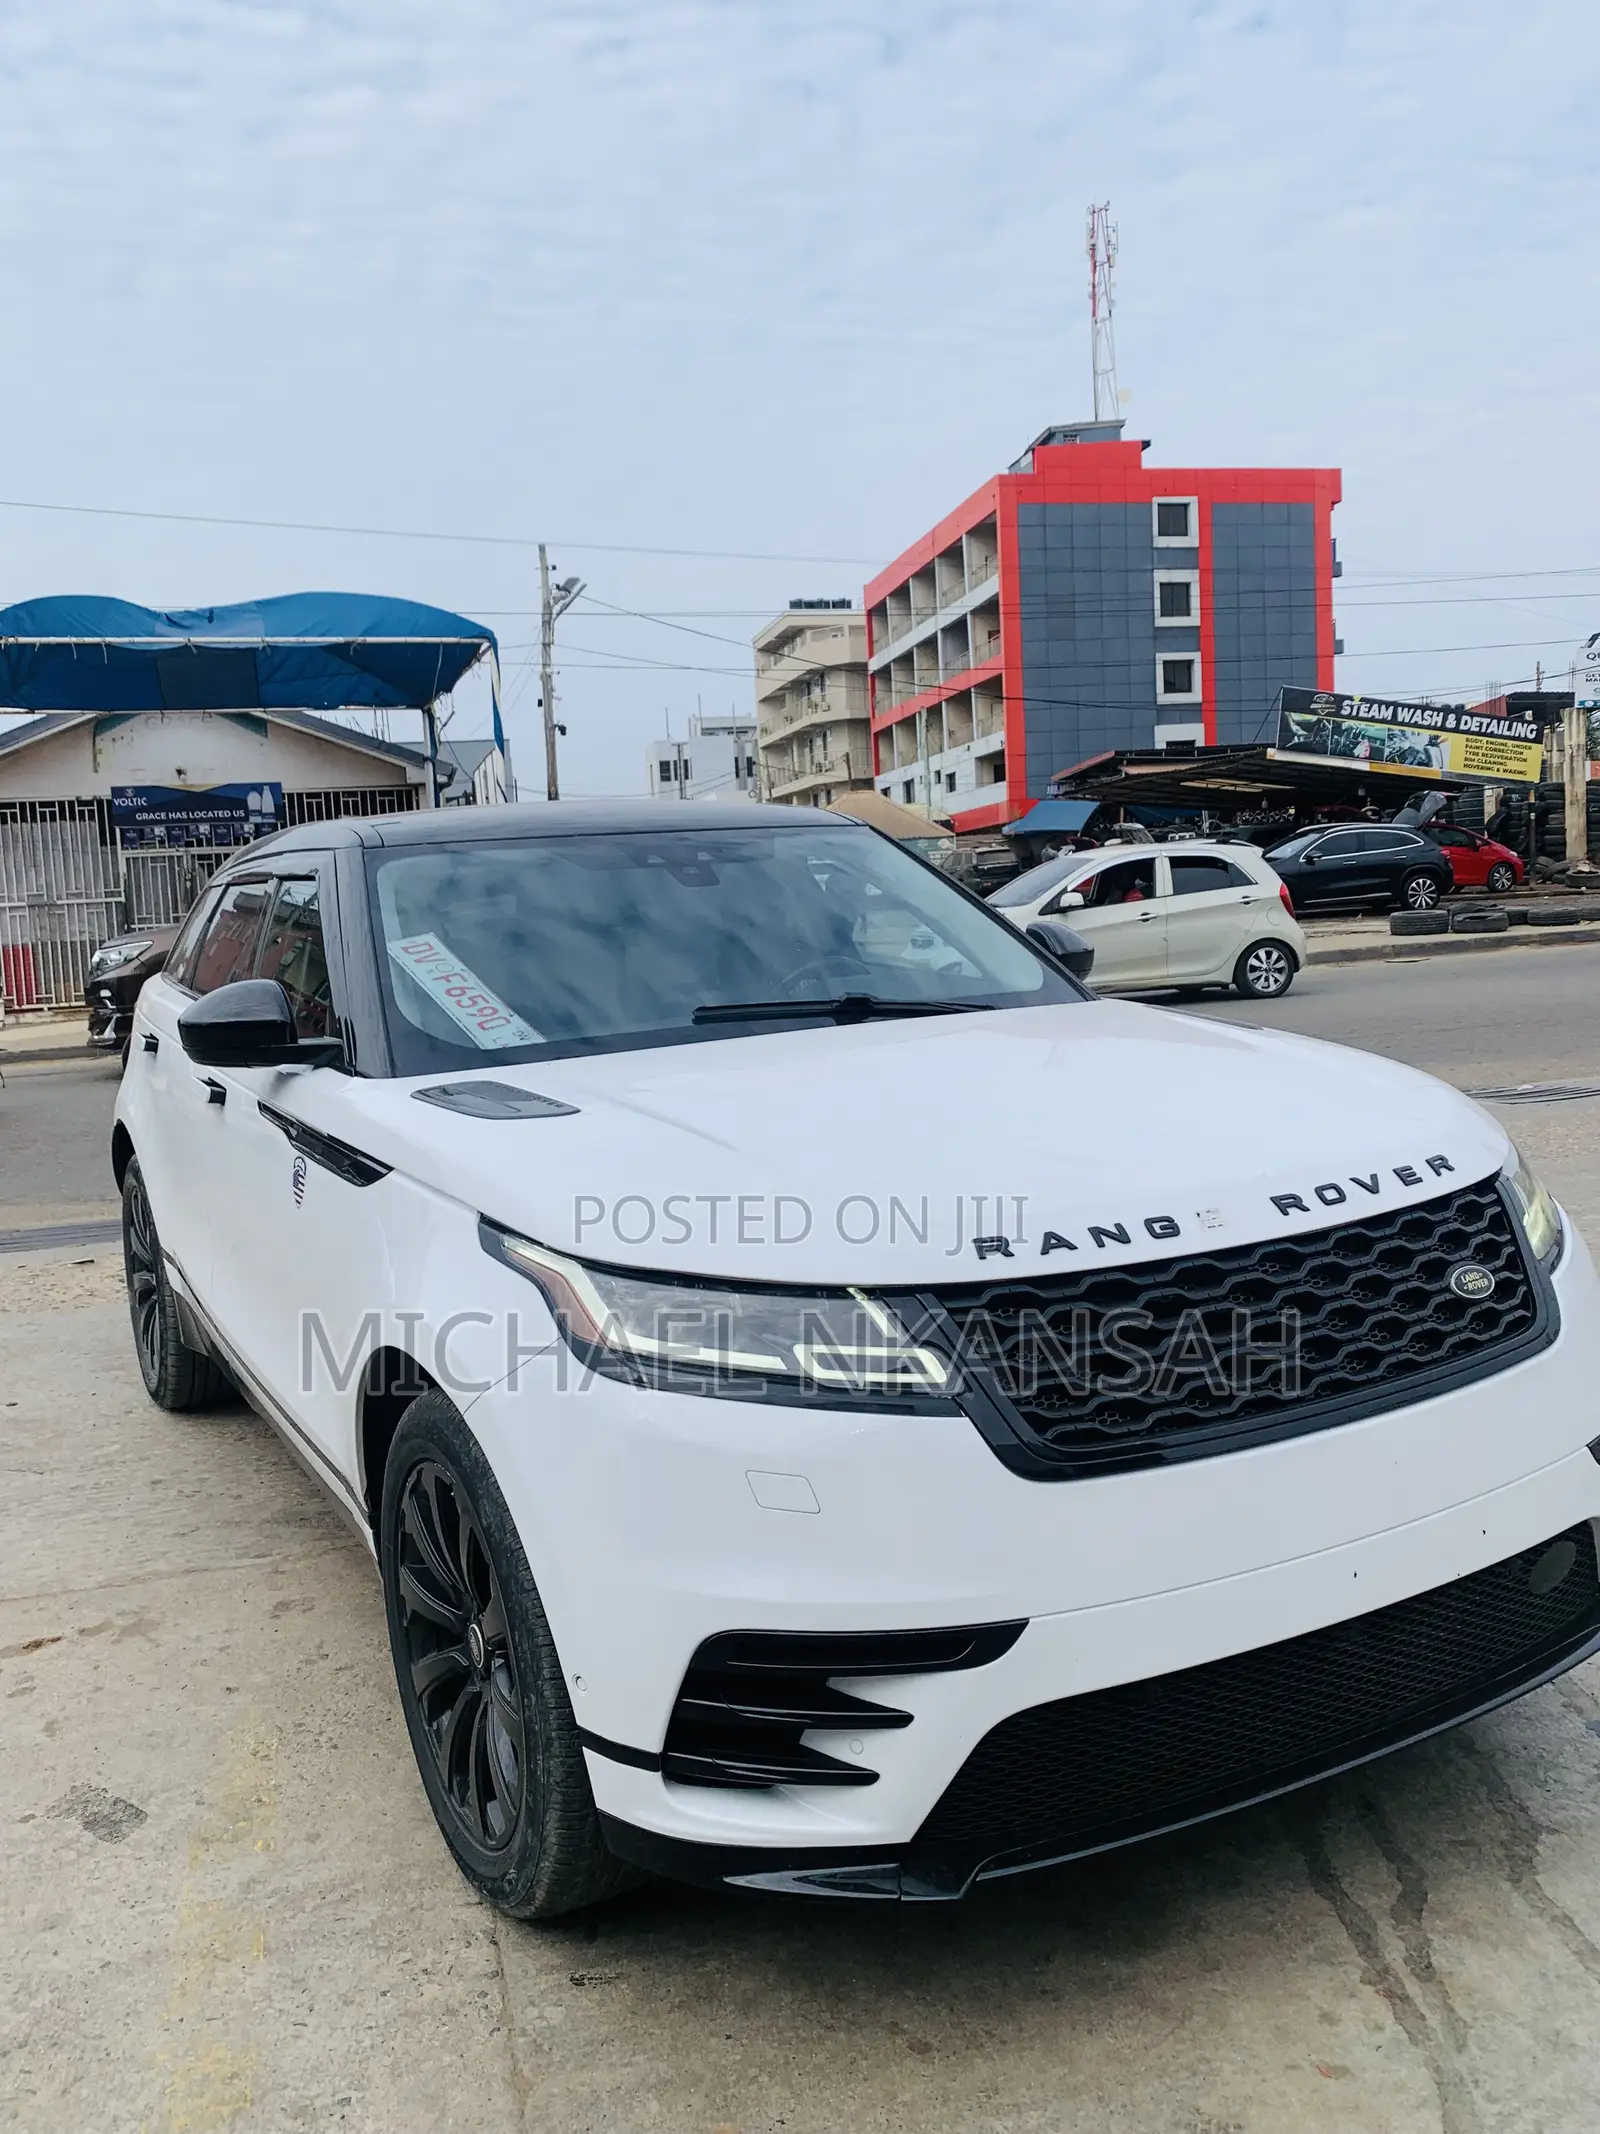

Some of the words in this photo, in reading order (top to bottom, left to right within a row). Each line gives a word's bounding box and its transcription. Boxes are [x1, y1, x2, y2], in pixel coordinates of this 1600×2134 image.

[1340, 700, 1394, 721] STEAM
[1397, 706, 1445, 727] WASH
[1445, 713, 1458, 729] &
[1459, 717, 1539, 739] DETAILING
[1465, 737, 1485, 745] BODY,
[1484, 745, 1525, 756] CORRECTION
[1476, 758, 1508, 767] CLEANING
[1481, 752, 1528, 763] REJUVENATION
[1463, 763, 1495, 772] HOVERING
[1502, 768, 1528, 776] WAXING
[113, 797, 148, 807] VOLTIC
[135, 811, 167, 821] GRACE
[168, 811, 188, 820] HAS
[189, 810, 232, 820] LOCATED
[232, 809, 246, 818] US
[973, 1207, 1227, 1260] RANG
[1269, 1154, 1455, 1216] ROVER
[1467, 1278, 1489, 1290] ROVER
